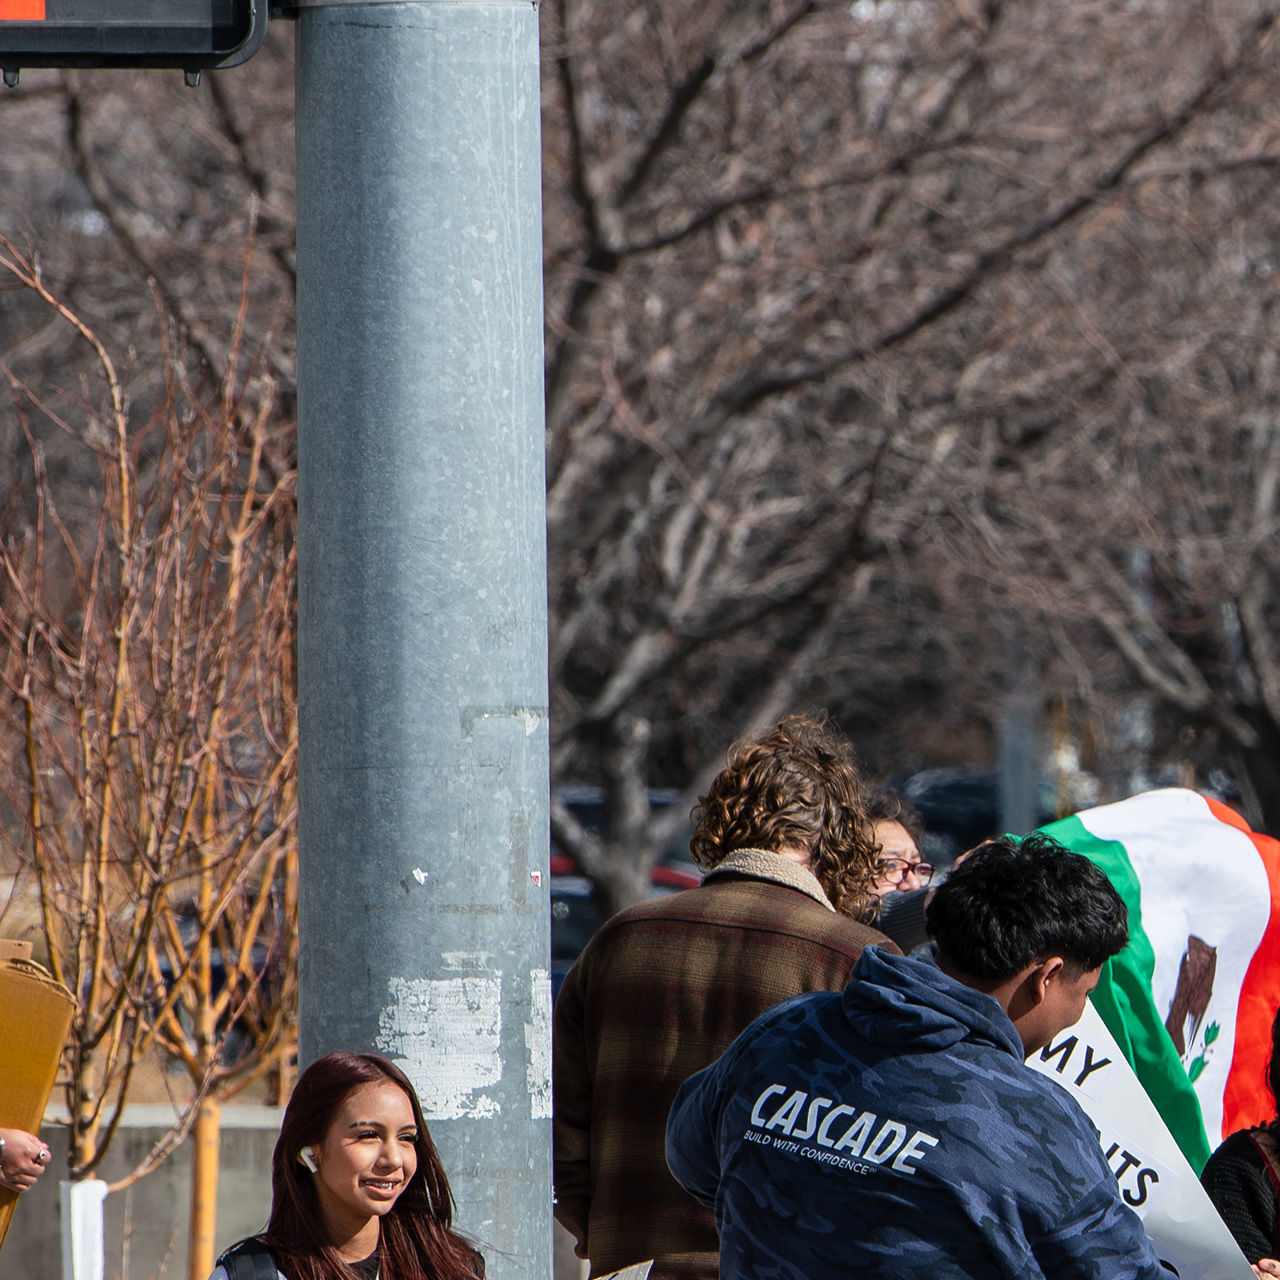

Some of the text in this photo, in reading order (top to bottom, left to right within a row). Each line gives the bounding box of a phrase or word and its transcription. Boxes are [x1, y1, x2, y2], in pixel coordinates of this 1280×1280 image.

[1039, 1034, 1113, 1087] MY
[743, 1129, 772, 1145] BUILD
[773, 1137, 801, 1154] WITH
[800, 1146, 871, 1176] CONFIDENCE
[750, 1083, 940, 1175] CASCADE
